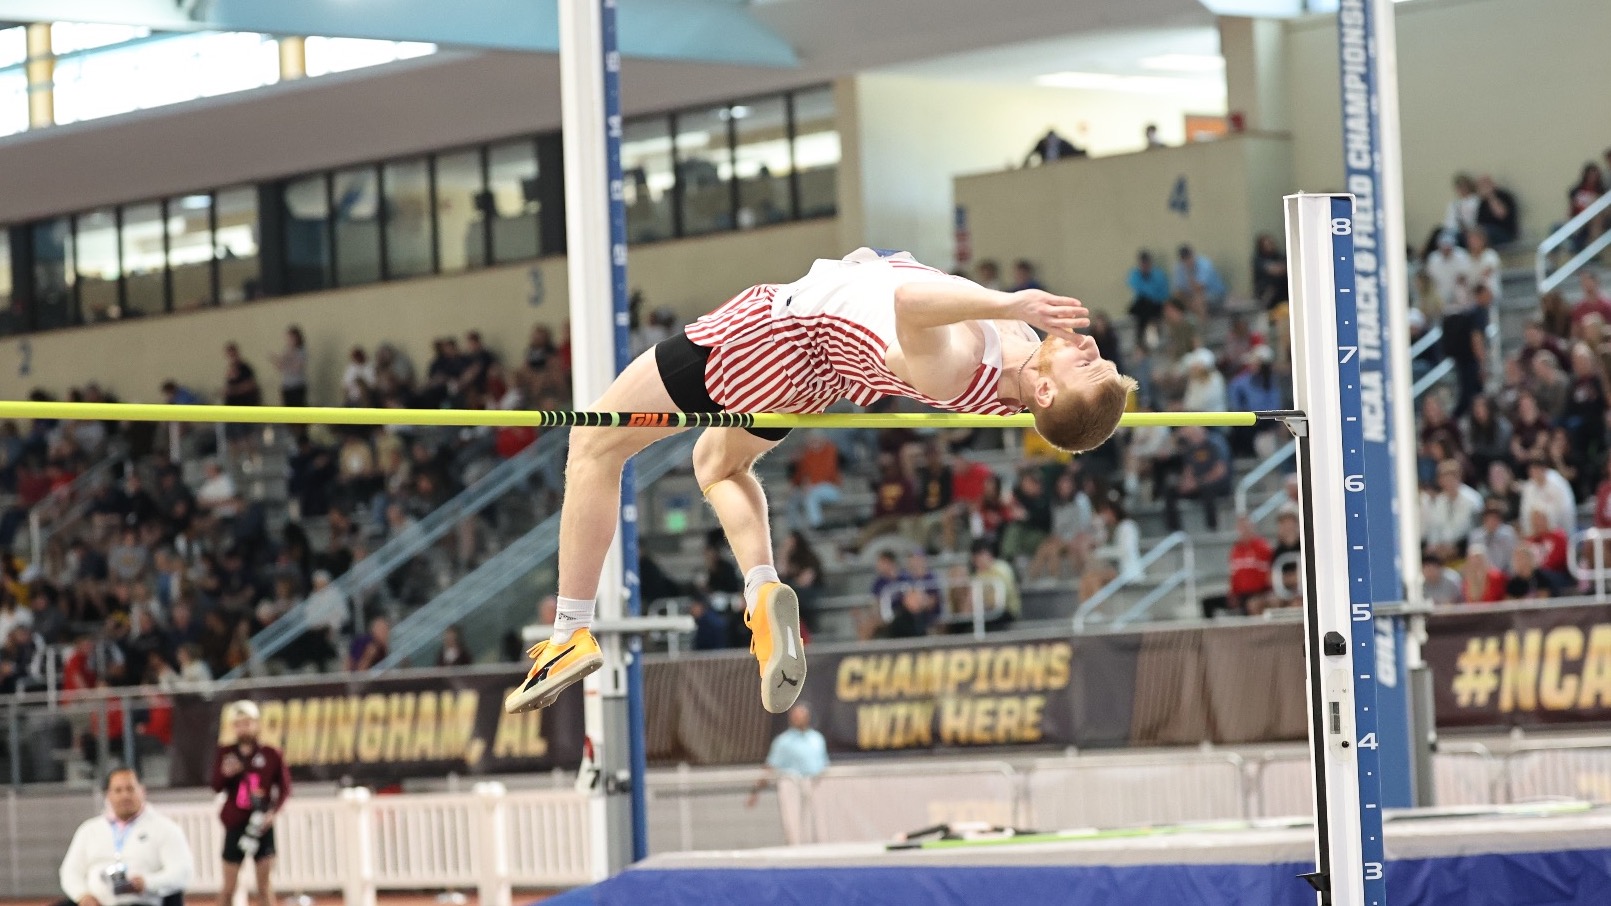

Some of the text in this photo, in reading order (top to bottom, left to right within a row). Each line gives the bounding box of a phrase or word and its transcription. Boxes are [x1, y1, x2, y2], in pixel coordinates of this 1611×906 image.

[1349, 174, 1378, 251] FIELD
[1331, 217, 1351, 235] 8
[1356, 280, 1382, 362] TRACK
[1338, 346, 1358, 363] 7
[1360, 370, 1387, 443] NCAA
[628, 413, 670, 426] GILL
[1344, 474, 1365, 492] 6
[1352, 603, 1372, 621] 5
[836, 643, 1073, 702] CHAMPIONS
[857, 695, 1047, 751] WIN HERE
[1357, 732, 1378, 750] 4
[1365, 862, 1383, 880] 3
